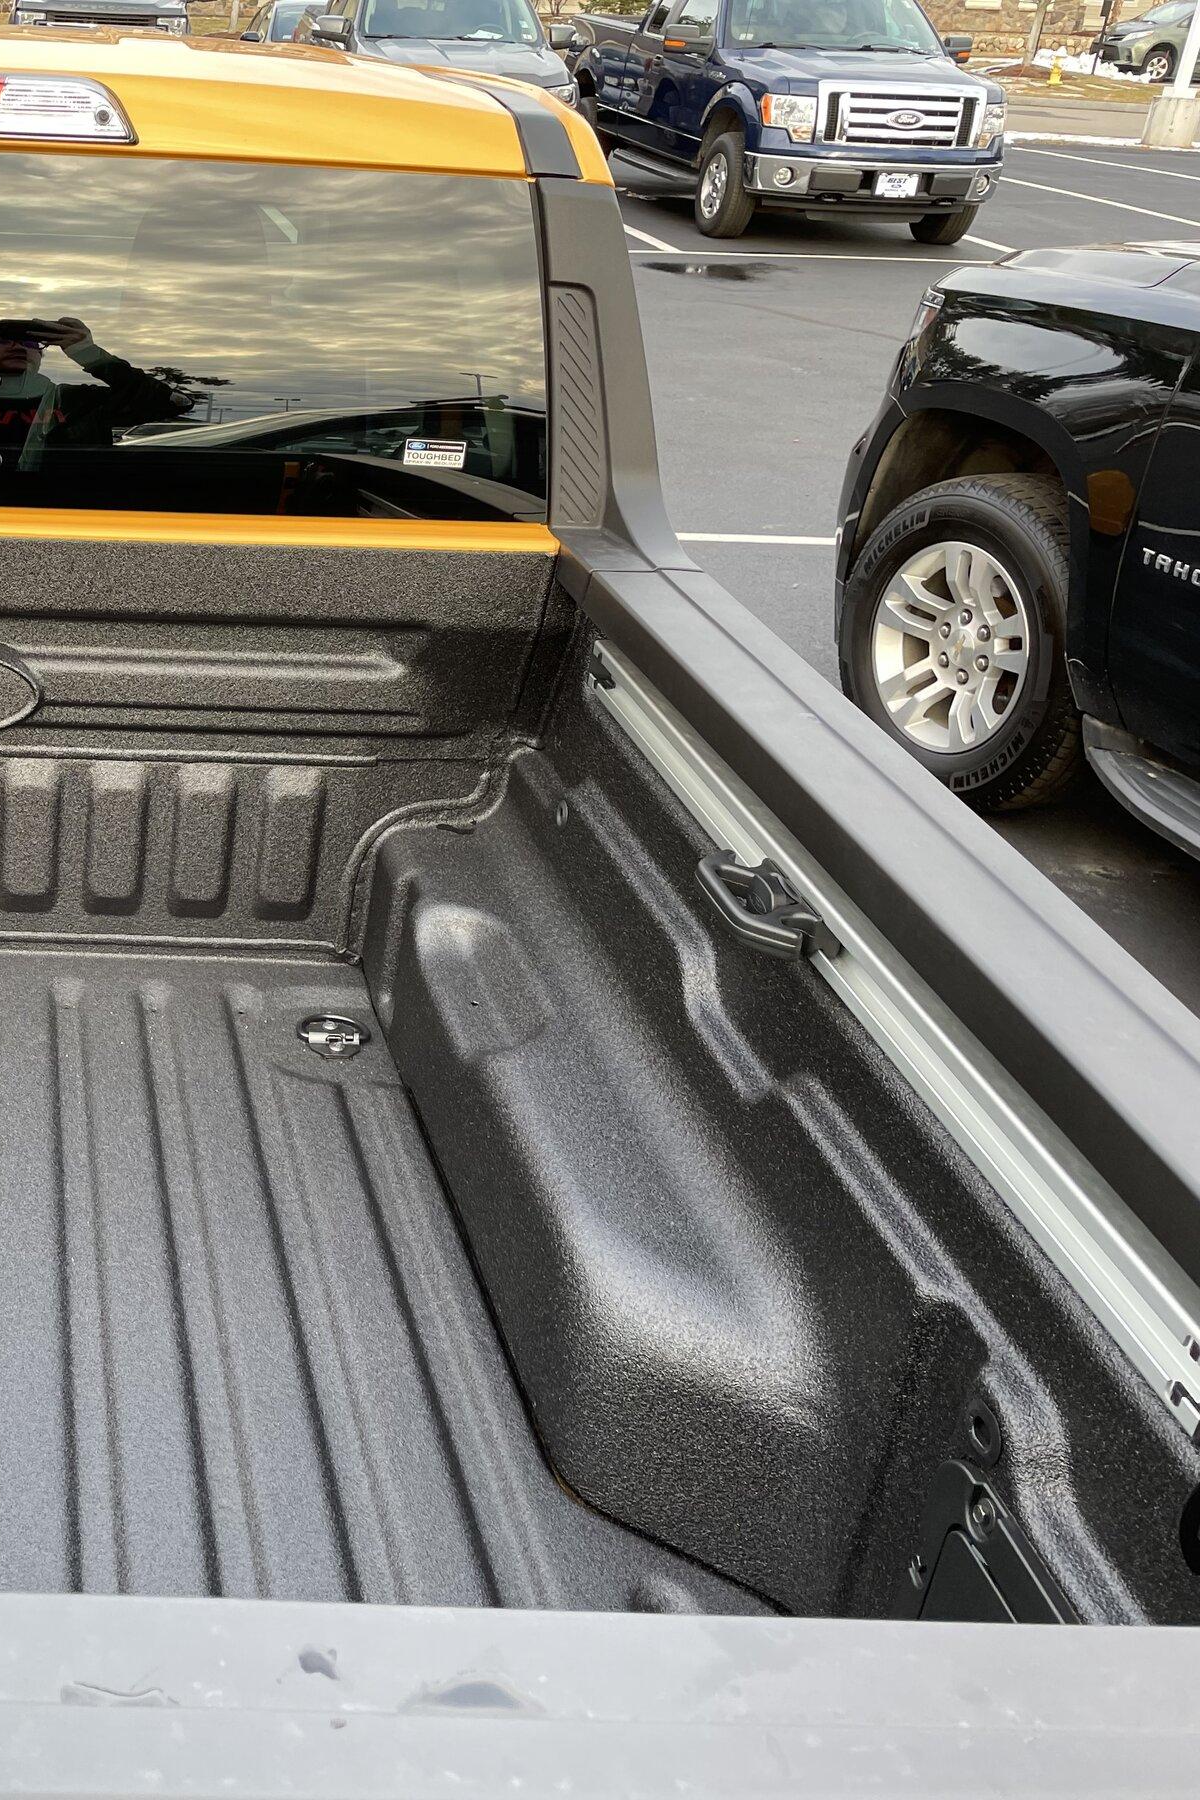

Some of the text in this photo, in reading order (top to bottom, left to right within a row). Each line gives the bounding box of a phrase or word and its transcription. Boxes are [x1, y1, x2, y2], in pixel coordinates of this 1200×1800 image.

[406, 451, 461, 462] TOUGHBED
[863, 508, 928, 576] MICHELIN
[952, 731, 1026, 790] MICHELIN
